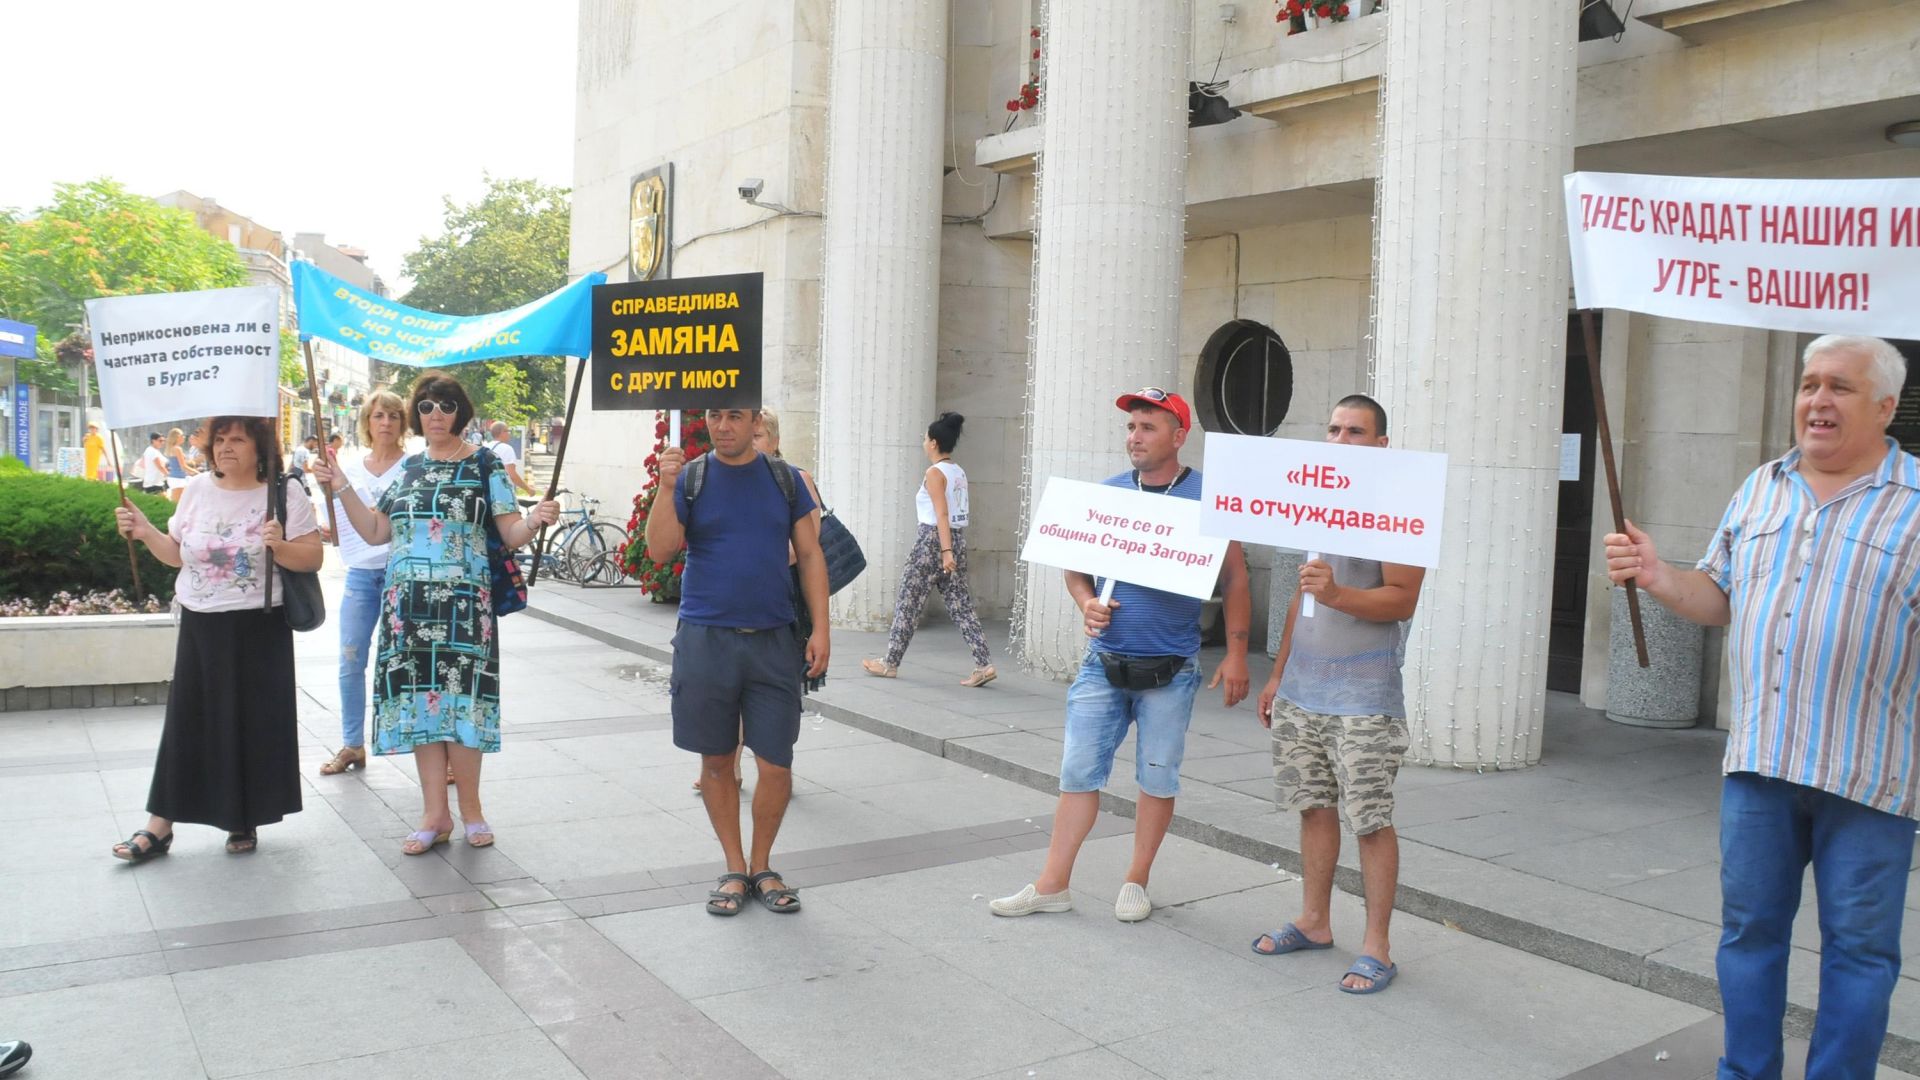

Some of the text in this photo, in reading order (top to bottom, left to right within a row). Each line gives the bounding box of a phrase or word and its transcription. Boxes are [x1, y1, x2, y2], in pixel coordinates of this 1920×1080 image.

[1580, 193, 1646, 233] ДНЕС
[1649, 199, 1752, 244] КРАДАТ
[1761, 204, 1878, 247] НАШИЯ
[1653, 258, 1870, 311] УТРЕ - ВАШИЯ!
[611, 292, 740, 316] СПРАВЕДЛИВА
[100, 322, 271, 346] Неприкосновена ли е
[338, 325, 367, 341] от
[361, 319, 392, 336] на
[401, 314, 453, 331] опит
[610, 323, 740, 357] ЗАМЯНА
[103, 344, 272, 369] частната собственост
[147, 365, 220, 387] в Бургас?
[610, 369, 740, 394] С ДРУГ ИМОТ
[18, 400, 28, 456] HAND MADE
[1286, 463, 1351, 490] «НЕ»
[1086, 508, 1175, 537] Учете се от
[1215, 494, 1425, 536] на отчуждаване
[1039, 523, 1214, 568] община Стара Загора!
